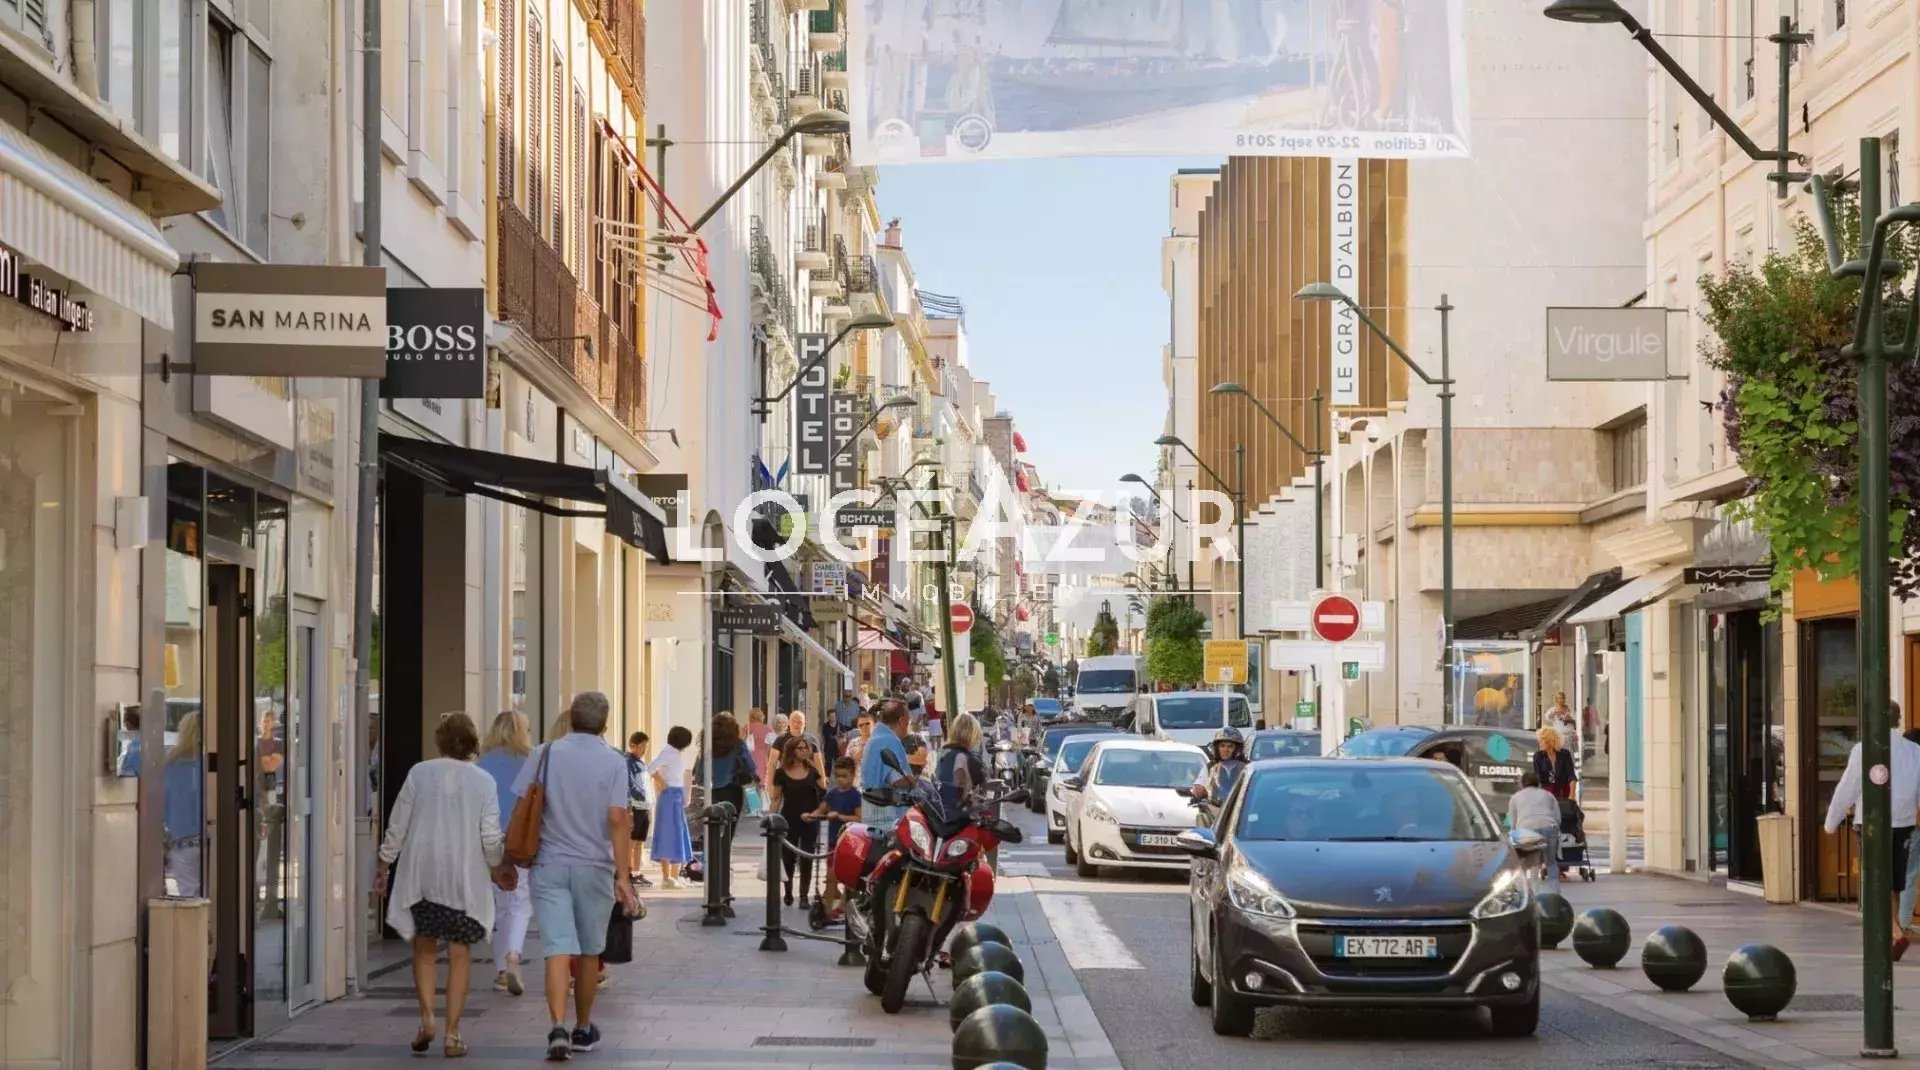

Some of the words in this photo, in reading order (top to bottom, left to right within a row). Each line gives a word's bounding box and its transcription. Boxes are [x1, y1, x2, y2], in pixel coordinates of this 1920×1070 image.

[1337, 164, 1353, 279] D'ALBION
[211, 308, 265, 328] SAN
[275, 310, 372, 332] MARINA
[384, 324, 477, 351] BOSS
[1553, 325, 1661, 362] Virgule
[434, 353, 475, 361] BOSS
[1337, 367, 1353, 393] LE
[800, 337, 826, 470] HOTEL
[833, 399, 854, 489] HOTEL
[1479, 765, 1524, 777] FLORELLA
